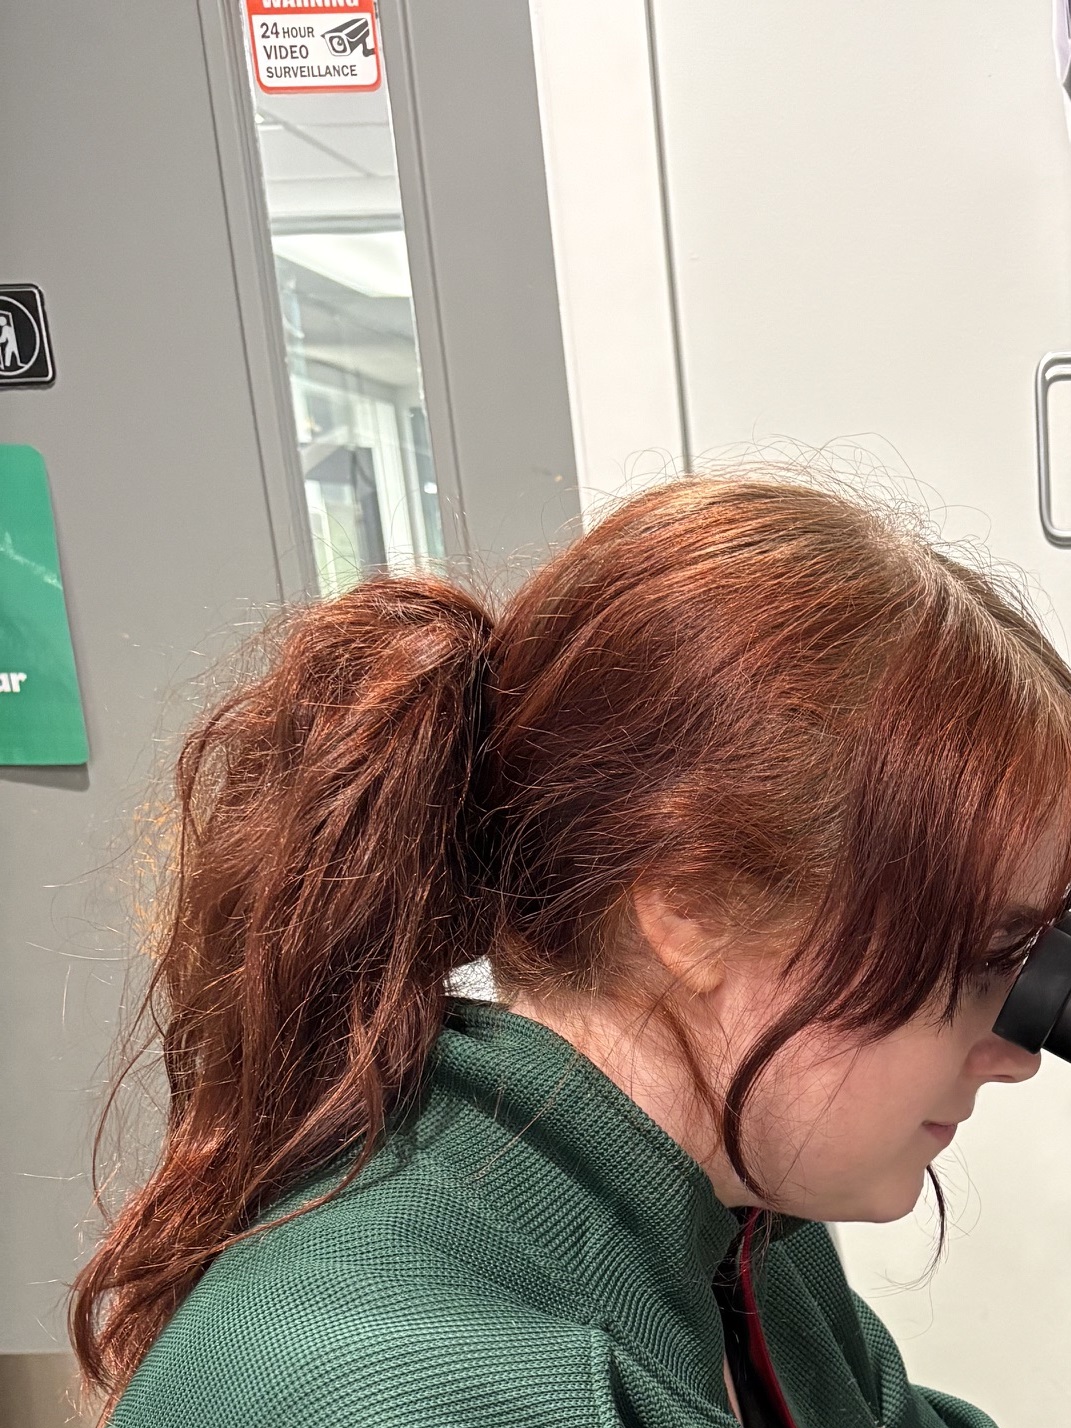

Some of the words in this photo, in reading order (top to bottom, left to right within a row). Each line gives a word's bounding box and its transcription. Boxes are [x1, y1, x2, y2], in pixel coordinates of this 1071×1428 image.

[260, 22, 280, 39] 24
[282, 26, 315, 38] HOUR
[263, 44, 309, 60] VIDEO
[266, 64, 358, 78] SURVEILLANCE
